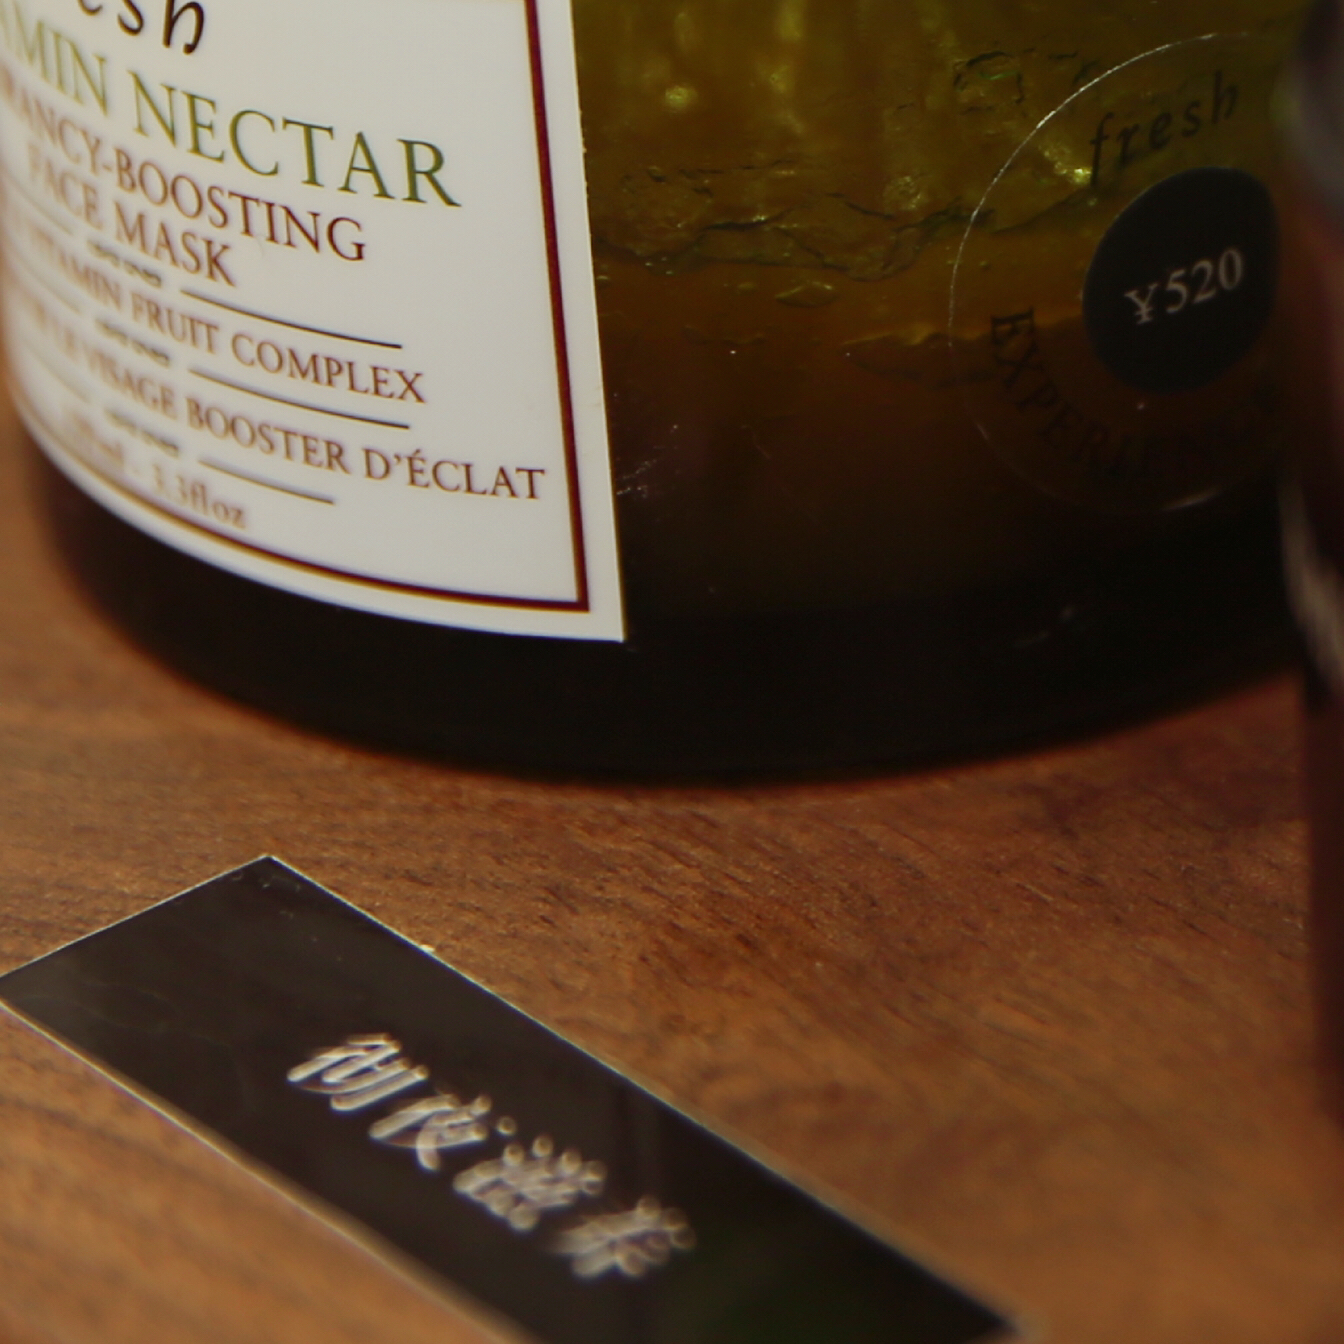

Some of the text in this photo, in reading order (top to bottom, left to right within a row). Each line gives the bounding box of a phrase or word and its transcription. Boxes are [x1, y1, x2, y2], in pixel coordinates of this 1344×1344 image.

[126, 69, 462, 209] NECTAR
[1088, 70, 1240, 189] fresh
[27, 141, 236, 288] FACE MASK
[1124, 248, 1245, 327] ¥520
[131, 290, 220, 355] FRUIT
[231, 331, 427, 405] COMPLEX
[186, 396, 351, 475] BOOSTER
[363, 447, 546, 501] D'ÉCLAT
